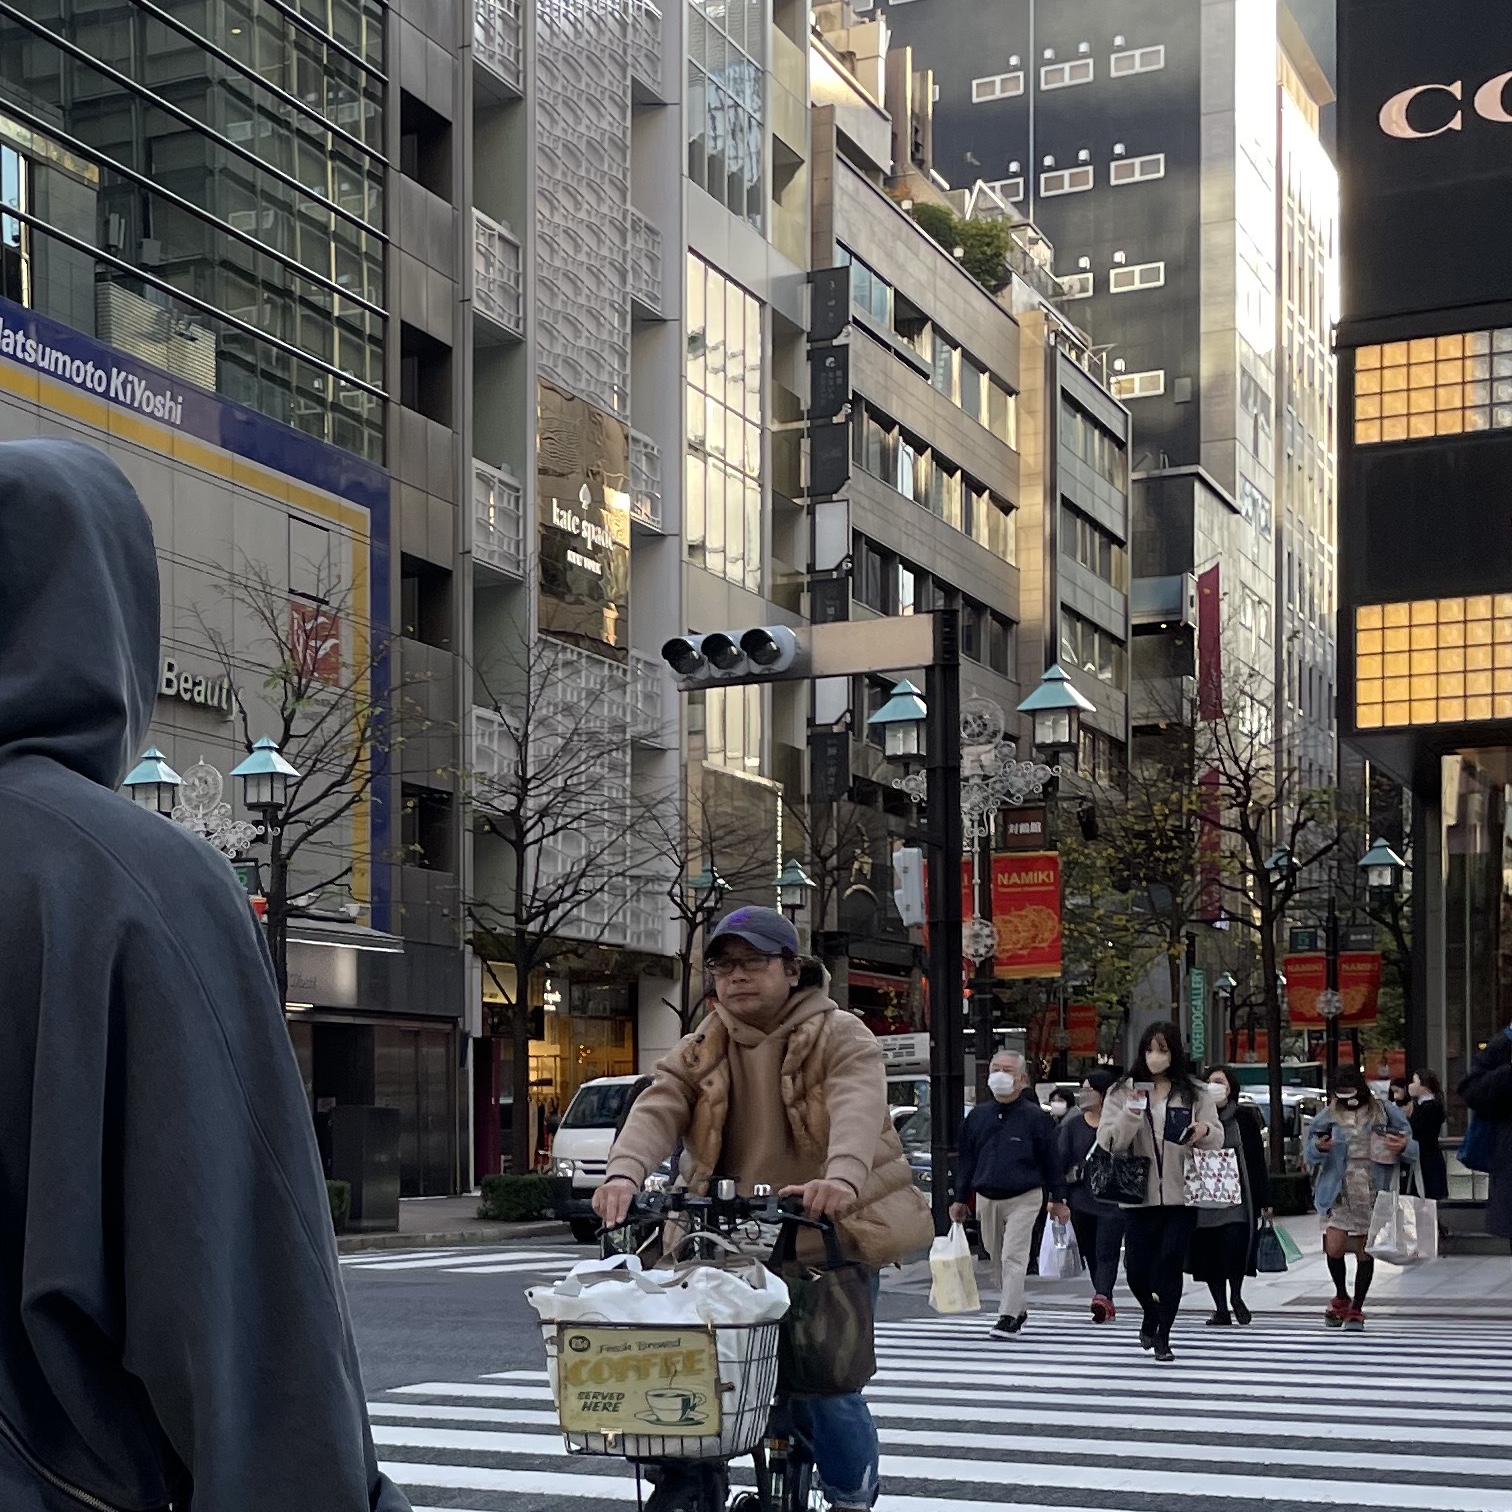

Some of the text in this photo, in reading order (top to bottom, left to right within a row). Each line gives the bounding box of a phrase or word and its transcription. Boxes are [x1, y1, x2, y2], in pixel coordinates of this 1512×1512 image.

[109, 367, 184, 425] KiYoshi
[551, 498, 580, 535] kate
[998, 871, 1054, 885] NAMIKI
[566, 1349, 706, 1386] COFFEE
[577, 1391, 625, 1401] SERVED
[581, 1401, 623, 1412] HERE
